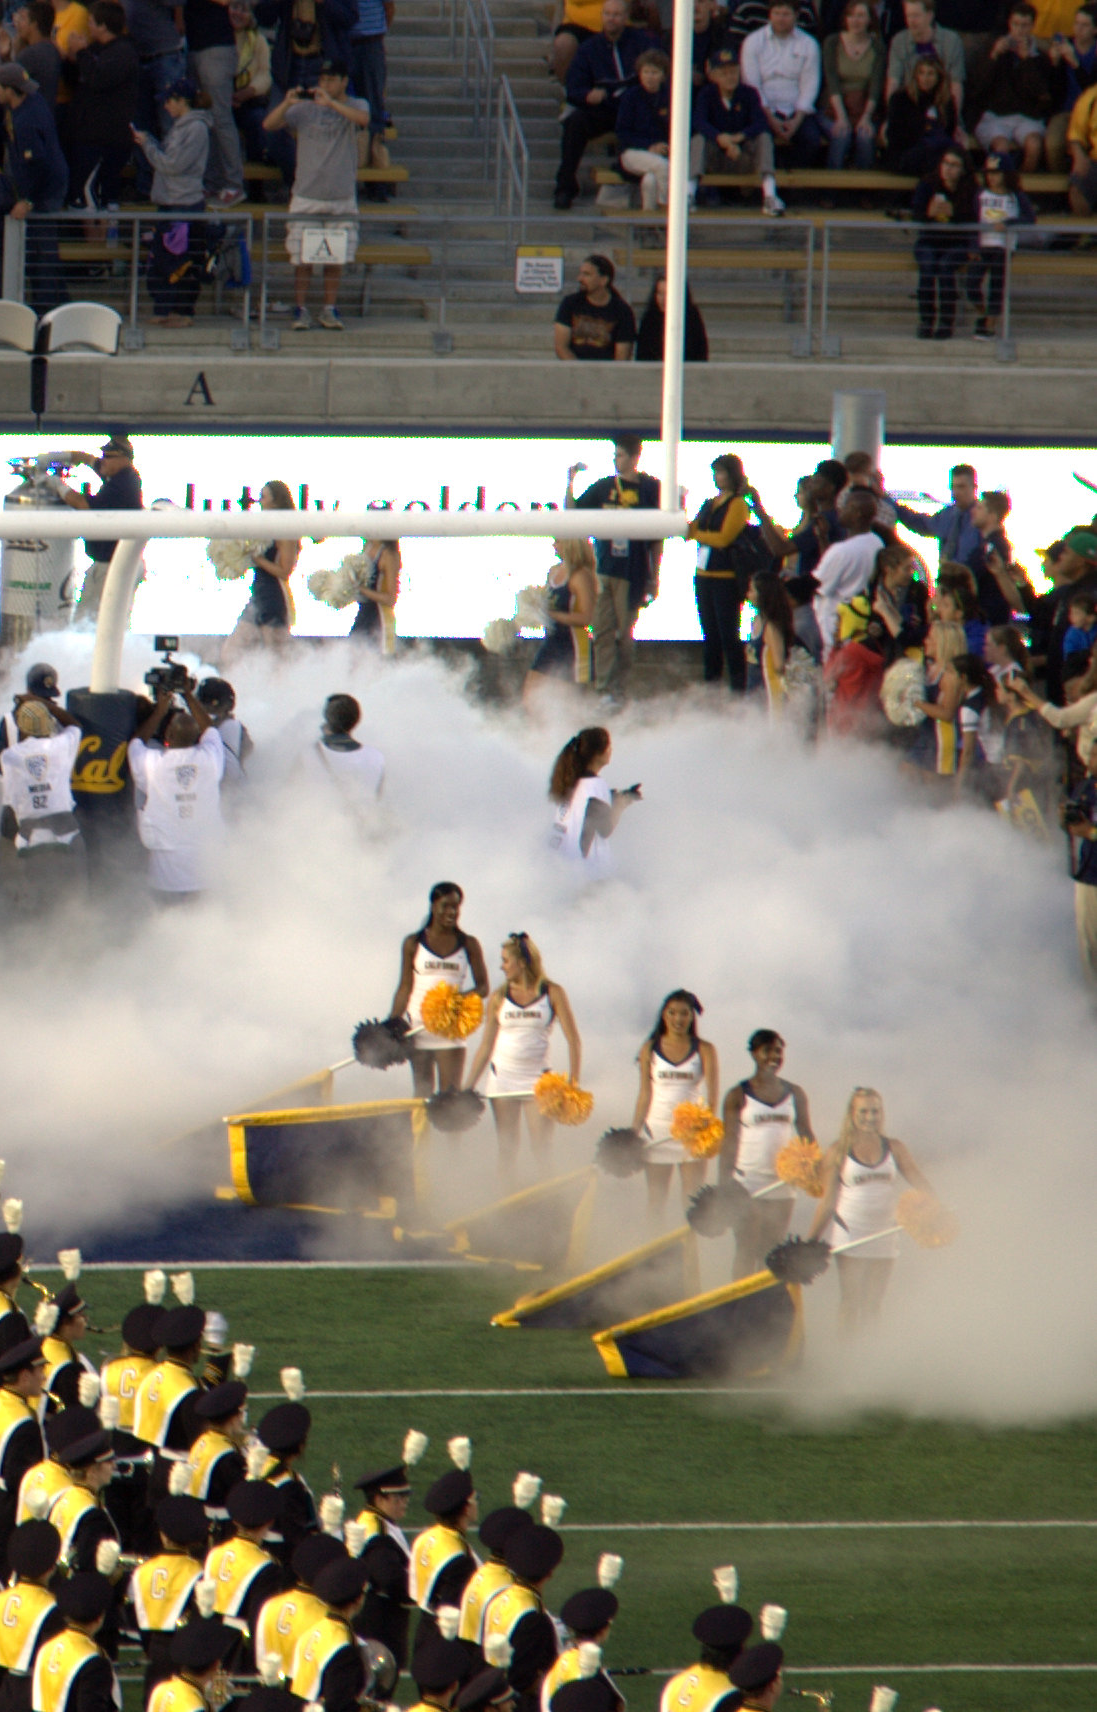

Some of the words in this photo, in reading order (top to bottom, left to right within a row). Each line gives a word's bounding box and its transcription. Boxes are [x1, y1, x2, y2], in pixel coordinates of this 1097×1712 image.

[316, 238, 332, 256] A
[183, 371, 217, 405] A
[72, 735, 128, 793] Cal
[29, 784, 52, 793] MEDIA
[425, 961, 460, 971] CALIFORNIA
[504, 1011, 541, 1019] CALIFORNIA
[659, 1071, 694, 1080] CALIFORNIA
[754, 1114, 790, 1123] CALIFORNIA
[120, 1369, 136, 1399] C
[149, 1372, 164, 1403] C
[218, 1550, 235, 1582] C
[151, 1569, 168, 1600] C
[3, 1595, 22, 1627] C
[277, 1602, 296, 1634] C
[47, 1641, 64, 1674] C
[304, 1630, 320, 1662] C
[678, 1674, 699, 1706] C
